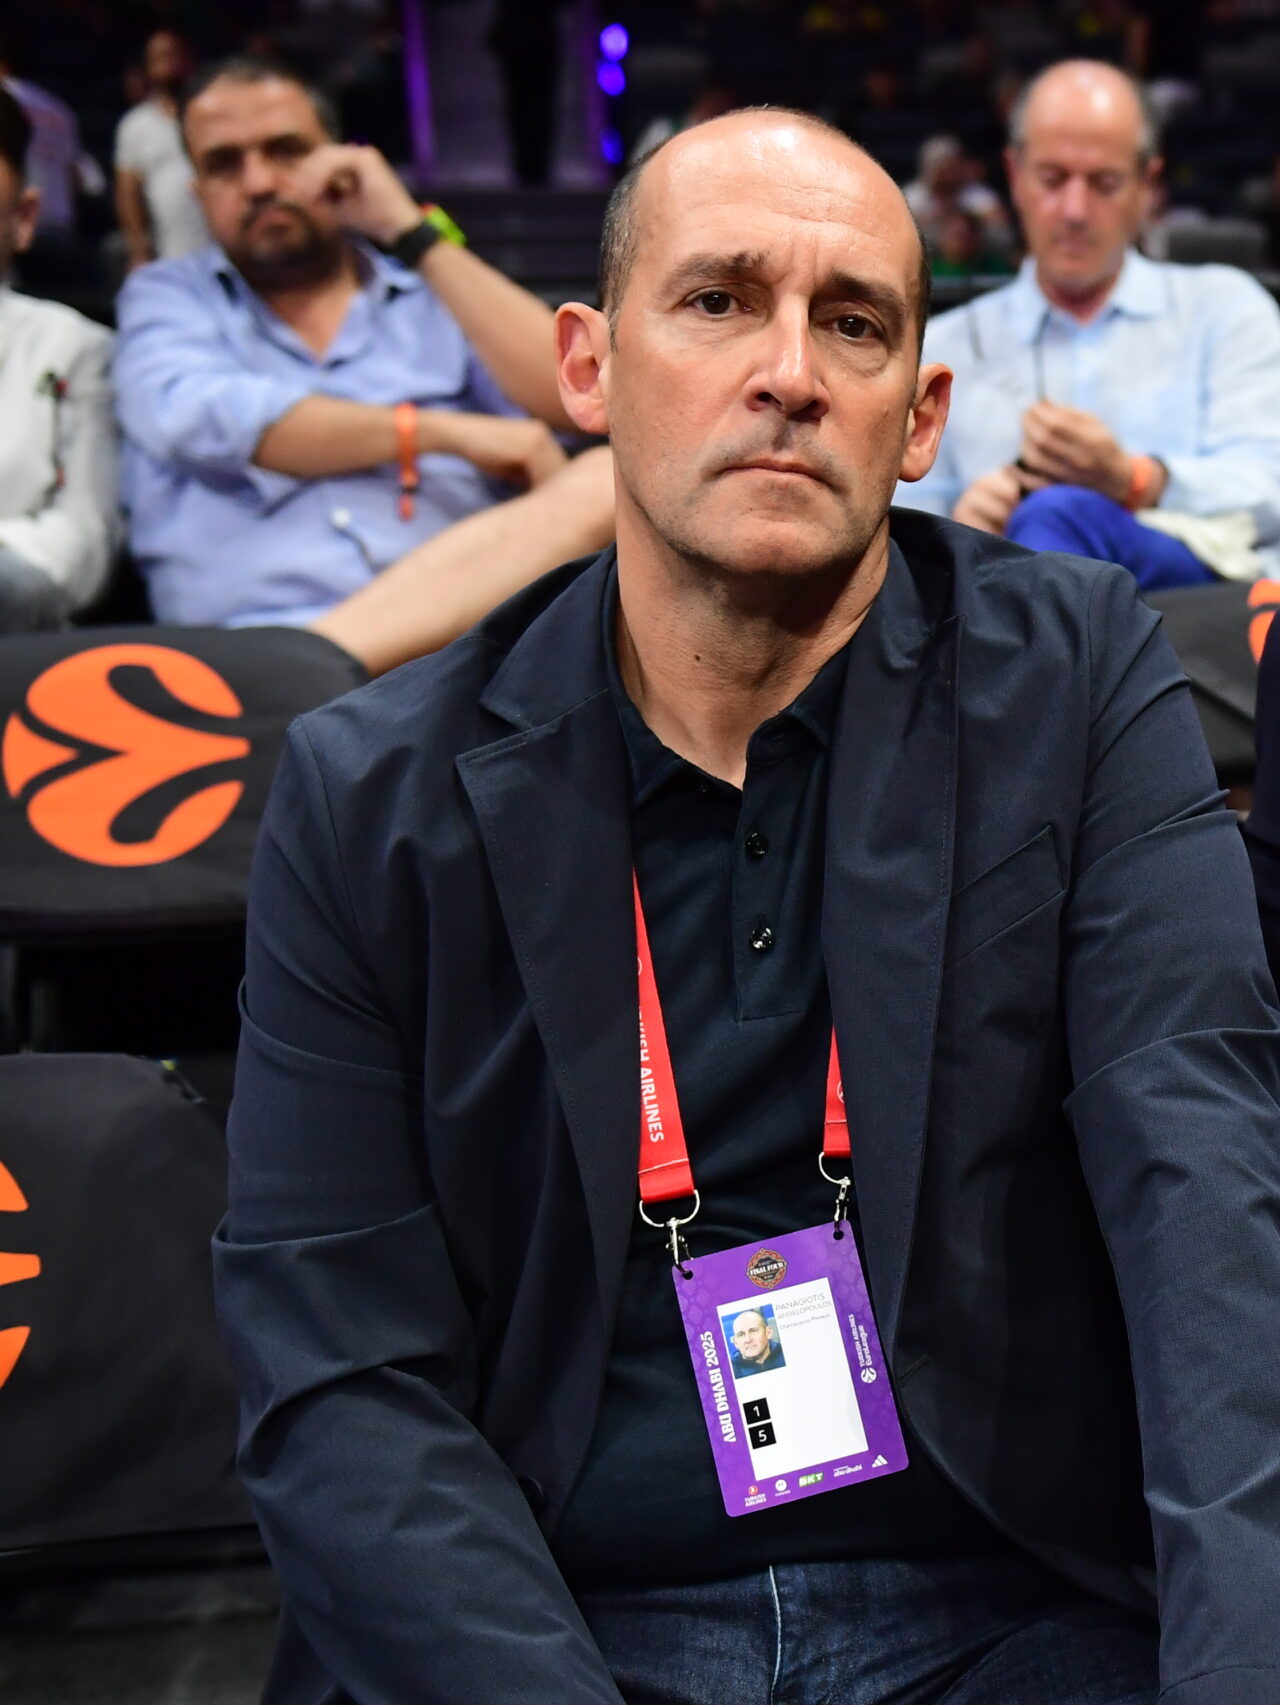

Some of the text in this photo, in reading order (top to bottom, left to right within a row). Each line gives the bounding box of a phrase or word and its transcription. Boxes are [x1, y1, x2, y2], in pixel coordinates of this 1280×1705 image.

[640, 1066, 665, 1143] AIRLINES
[775, 1293, 825, 1311] PANAGIOTIS
[700, 1330, 737, 1443] ABU DHABI 2025
[752, 1405, 761, 1418] 1
[758, 1430, 767, 1442] 5
[799, 1473, 823, 1487] BKT
